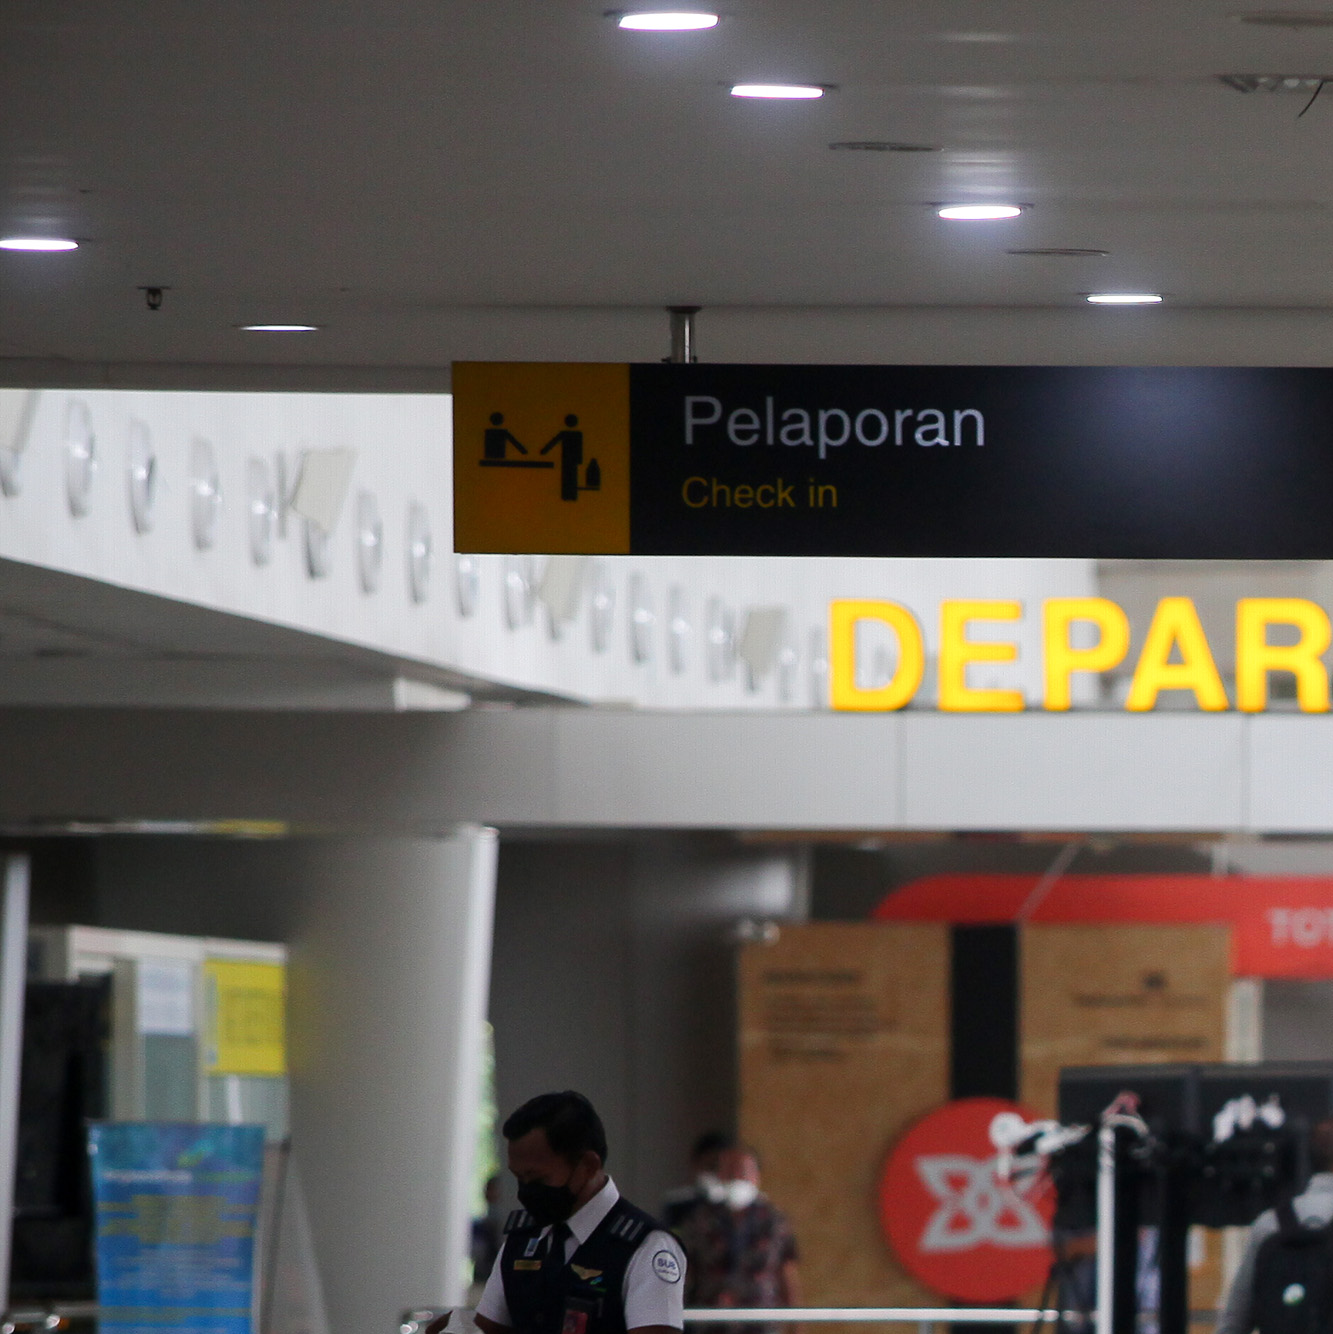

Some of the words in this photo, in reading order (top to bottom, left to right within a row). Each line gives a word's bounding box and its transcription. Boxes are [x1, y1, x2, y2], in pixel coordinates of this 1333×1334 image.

[682, 395, 985, 459] Pelaporan
[681, 476, 796, 508] Check
[809, 476, 838, 508] in
